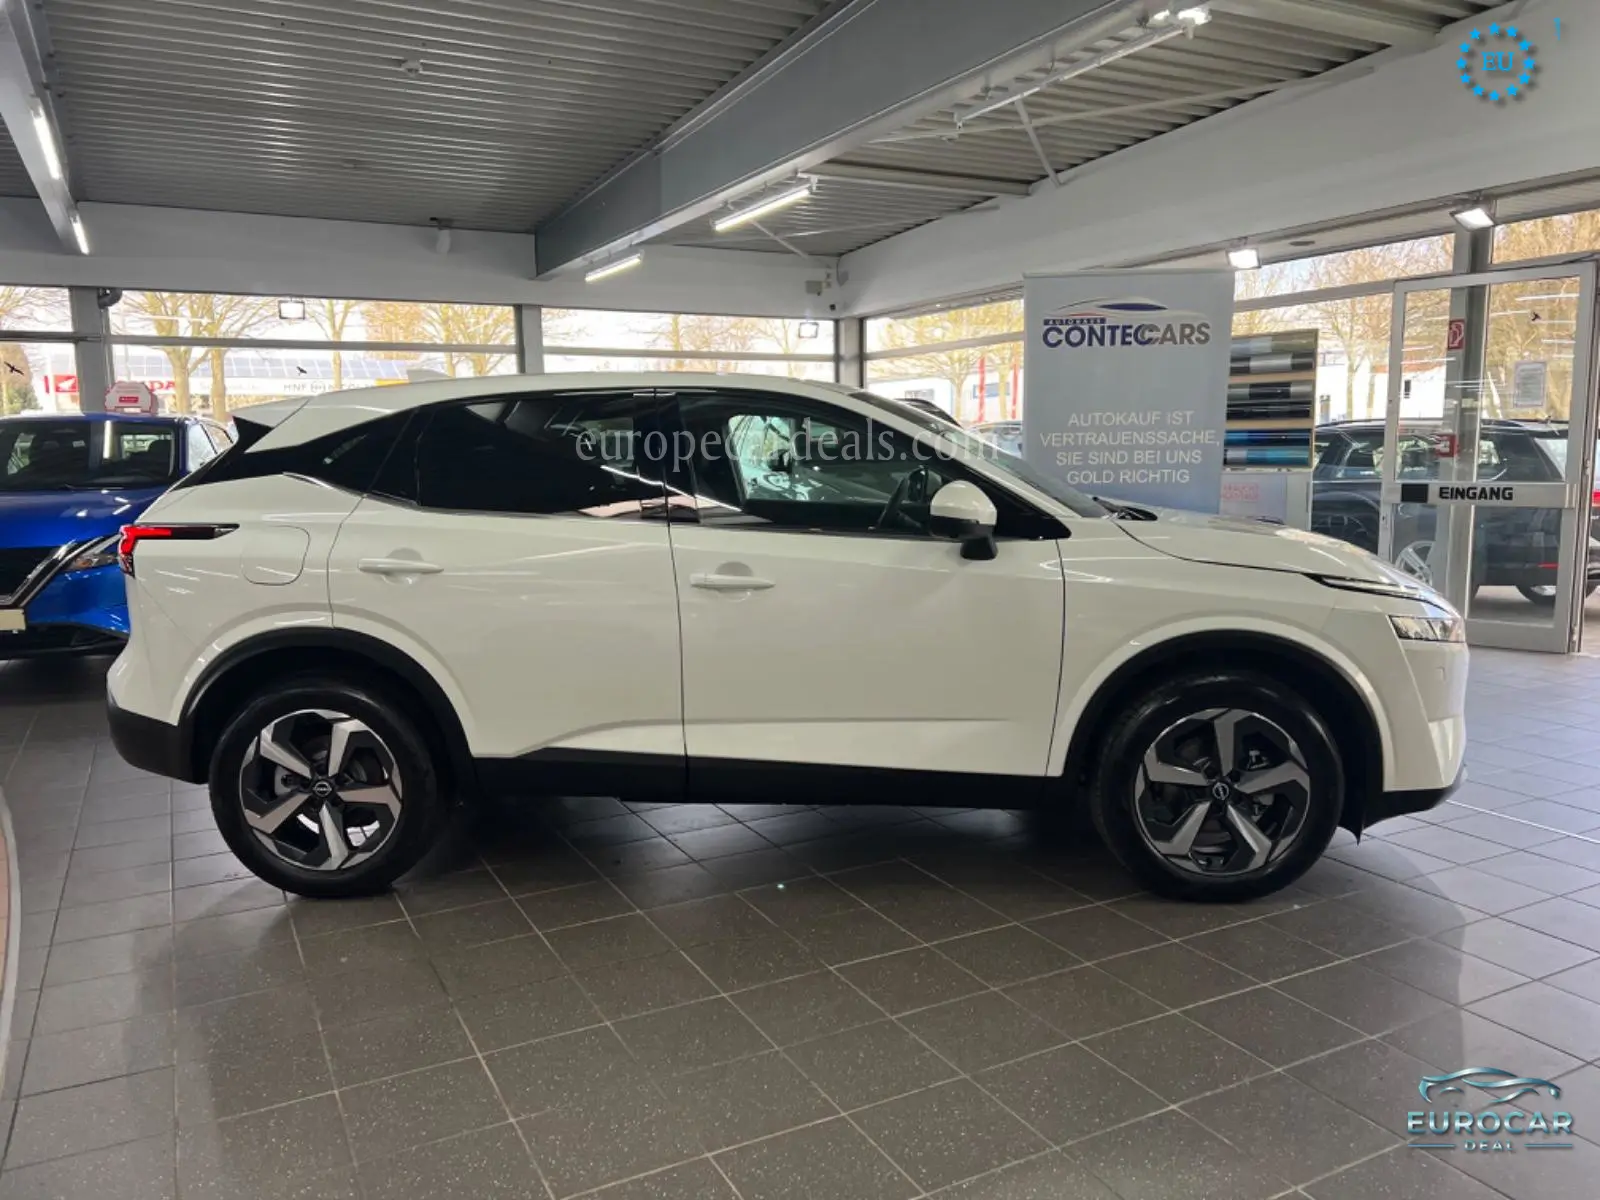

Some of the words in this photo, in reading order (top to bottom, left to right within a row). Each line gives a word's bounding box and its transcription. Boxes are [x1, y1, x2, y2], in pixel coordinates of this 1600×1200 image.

[1068, 412, 1161, 426] AUTOKAUF
[1167, 411, 1194, 425] IST
[1040, 430, 1220, 447] VERTRAUENSSACHE,
[1056, 451, 1083, 466] SIE
[1088, 451, 1128, 465] SIND
[1134, 450, 1161, 464] BEI
[1166, 450, 1202, 464] UNS
[1067, 470, 1115, 485] GOLD
[1120, 469, 1190, 483] RICHTIG
[1439, 486, 1514, 501] EINGANG
